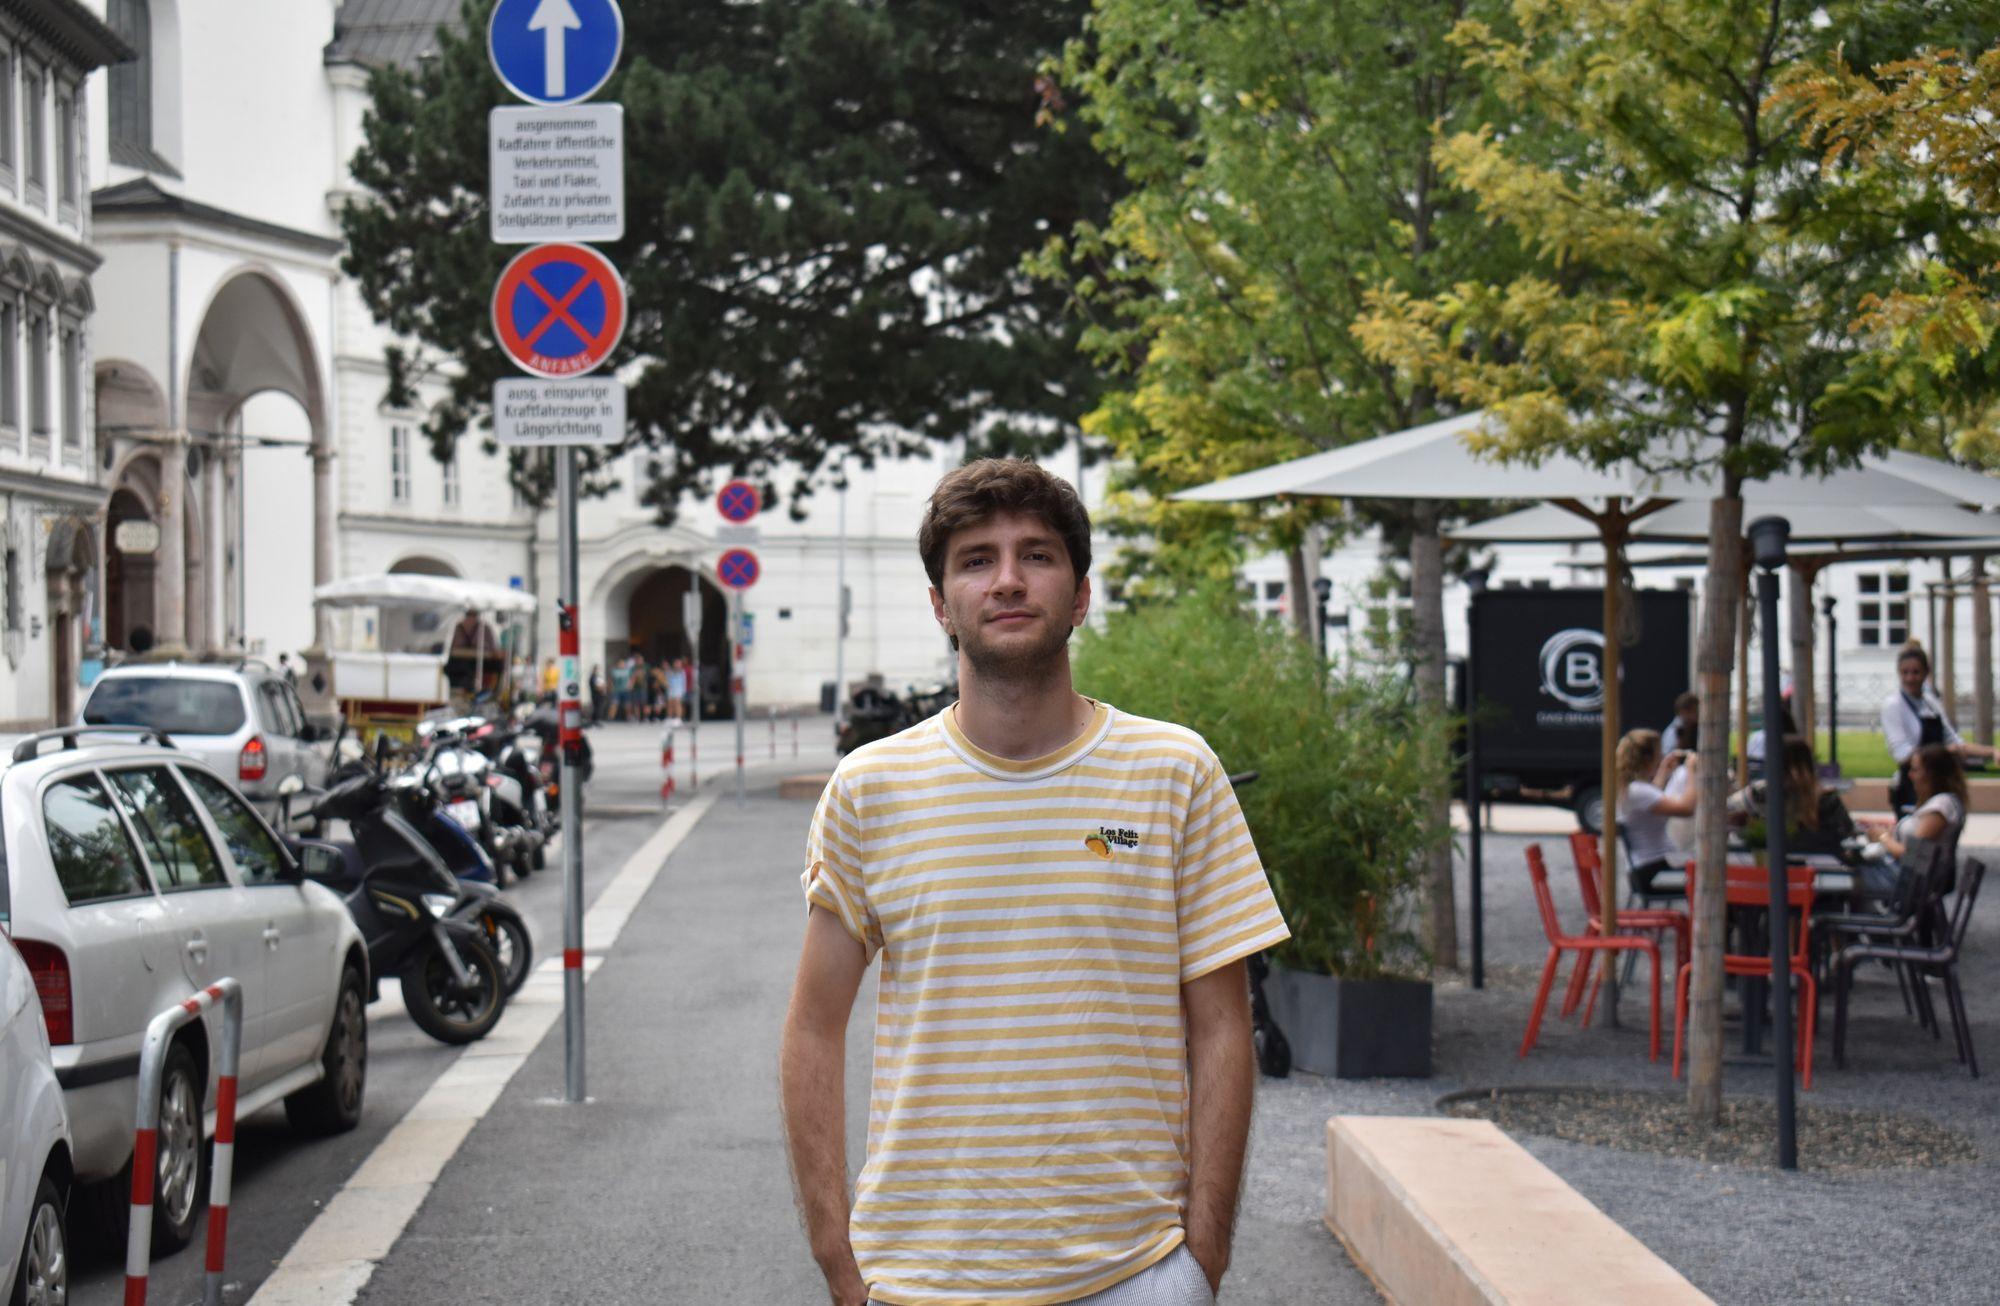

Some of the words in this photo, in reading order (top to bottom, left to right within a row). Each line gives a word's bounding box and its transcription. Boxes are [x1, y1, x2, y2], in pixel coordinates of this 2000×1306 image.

[516, 119, 597, 134] ausgenommen
[498, 137, 552, 151] Radfahrer
[556, 136, 616, 149] öffentliche
[514, 155, 600, 169] Verkehrsmittel,
[513, 175, 537, 188] Taxi
[540, 175, 560, 188] und
[563, 174, 601, 189] Fiaker,
[503, 194, 545, 208] Zufahrt
[548, 196, 560, 206] zu
[564, 194, 612, 208] privaten
[498, 213, 562, 228] Stellplätzen
[566, 212, 618, 229] gestattet
[529, 353, 592, 374] ANFANG
[544, 385, 609, 402] einspurige
[504, 403, 598, 419] Kraftfahrzeuge
[601, 402, 613, 416] in
[514, 422, 603, 439] Längsrichtung
[1566, 652, 1599, 687] B
[1100, 827, 1116, 836] Los
[1118, 828, 1138, 838] Feliz
[1106, 835, 1138, 848] Village
